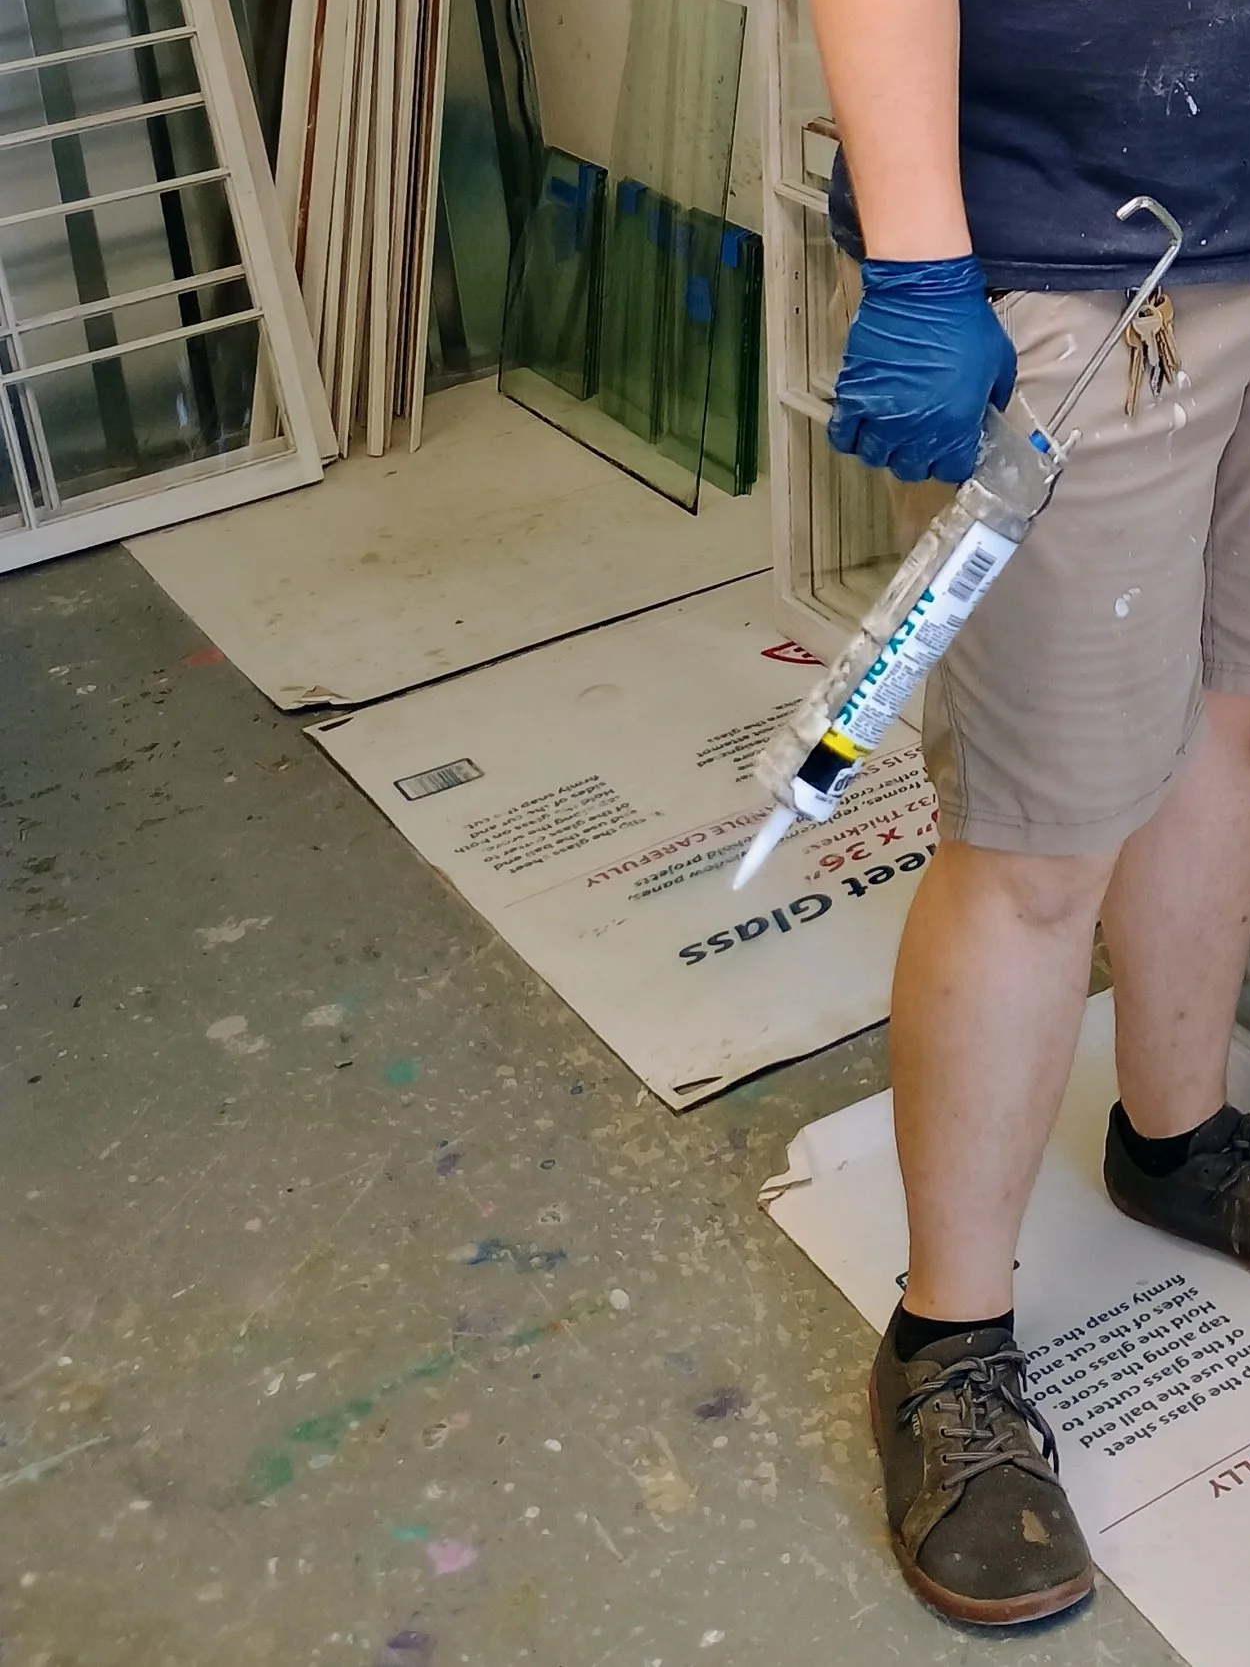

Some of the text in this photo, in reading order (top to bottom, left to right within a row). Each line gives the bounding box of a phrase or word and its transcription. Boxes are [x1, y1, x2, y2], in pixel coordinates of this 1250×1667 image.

[883, 757, 902, 767] IS
[879, 771, 918, 789] other
[862, 782, 921, 805] frames,
[877, 827, 903, 846] x
[588, 833, 706, 887] CAREFULLY
[679, 894, 832, 965] Glass
[1133, 1275, 1185, 1303] firmly
[1087, 1303, 1129, 1328] snap
[1025, 1288, 1198, 1384] sides of the cut and
[1053, 1328, 1085, 1346] the
[1025, 1301, 1216, 1410] Hold the glass on bot
[1053, 1316, 1230, 1409] tap along the score.
[1062, 1330, 1243, 1431] of the glass cutter to
[1191, 1364, 1223, 1383] use
[1157, 1383, 1190, 1401] the
[1209, 1378, 1241, 1396] the
[1119, 1401, 1158, 1426] ball
[1159, 1393, 1206, 1424] glass
[1080, 1423, 1116, 1448] end
[1104, 1423, 1156, 1456] sheet
